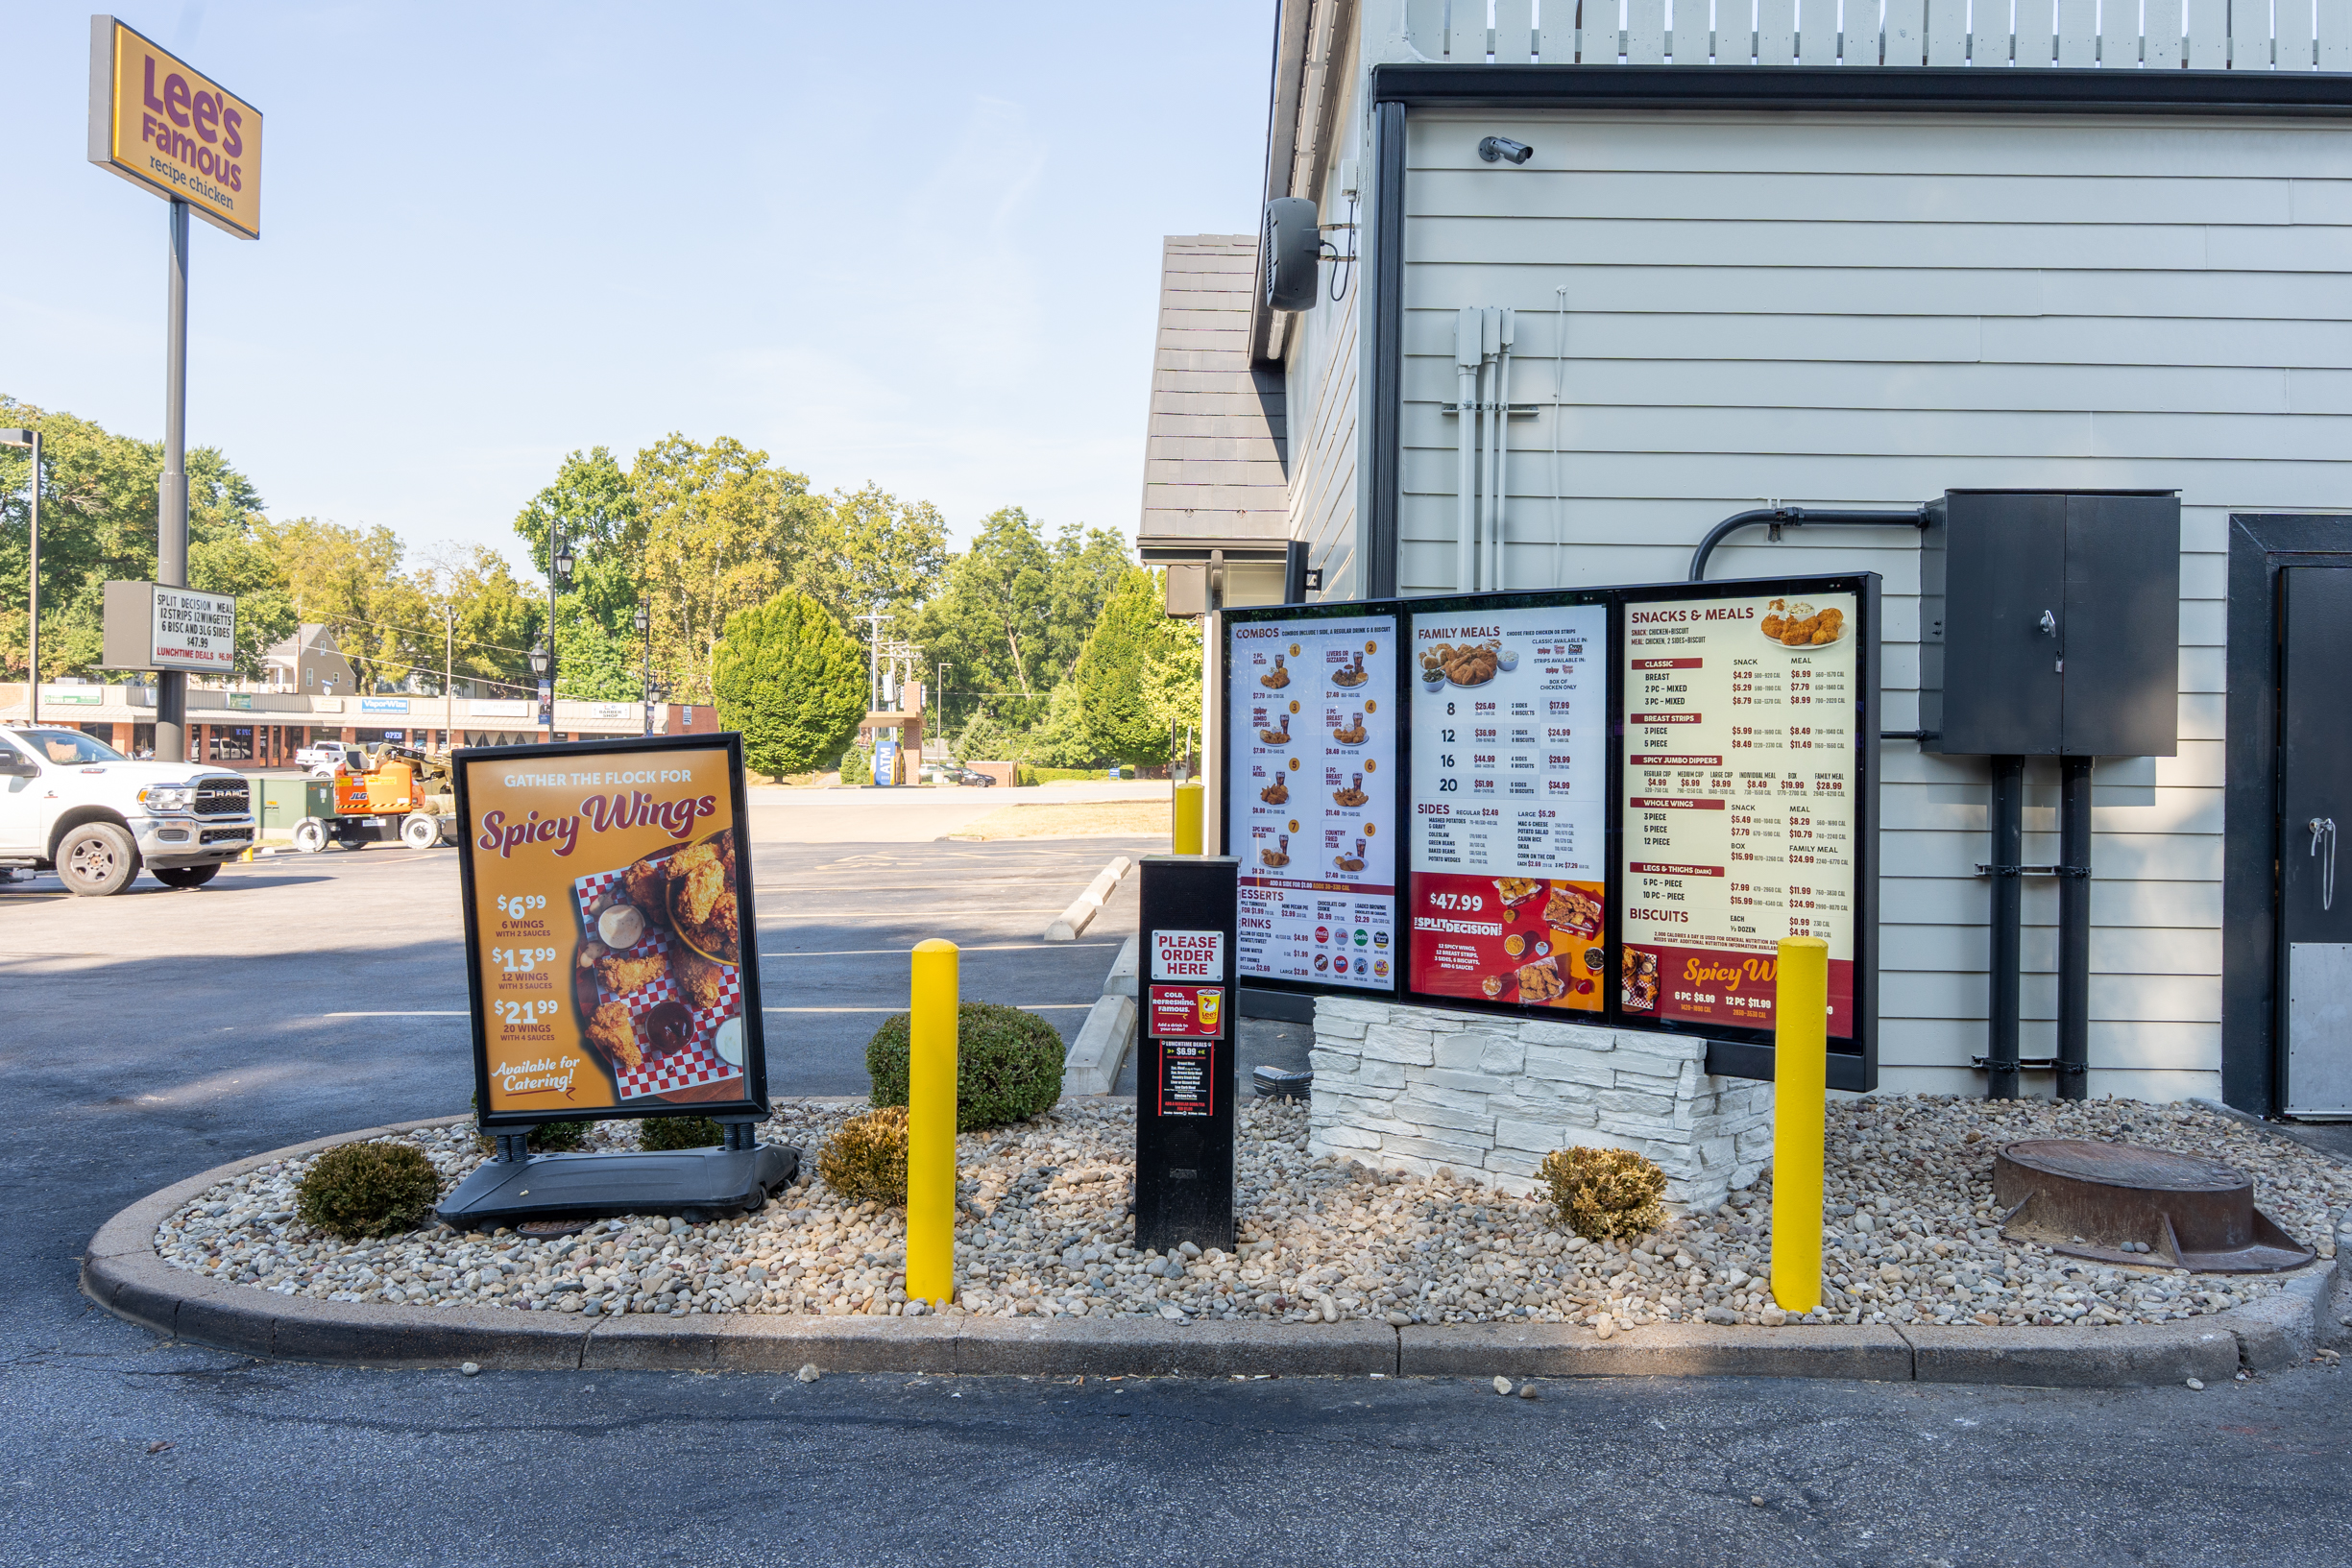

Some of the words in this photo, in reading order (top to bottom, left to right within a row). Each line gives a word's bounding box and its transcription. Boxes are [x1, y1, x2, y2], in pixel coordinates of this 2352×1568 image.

[143, 54, 243, 158] Lee's
[143, 111, 242, 192] Famous
[150, 156, 186, 185] recipe
[189, 176, 233, 210] chicken
[158, 594, 177, 606] SPLIT
[182, 598, 210, 611] DECISION
[217, 602, 233, 614] MEAL
[1632, 611, 1686, 623] SNACKS
[1691, 610, 1702, 621] &
[1705, 607, 1754, 620] MEALS
[162, 621, 166, 631] 6
[168, 622, 183, 633] BISC
[185, 623, 198, 634] AND
[213, 627, 230, 638] SIDES
[1236, 628, 1278, 639] COMBOS
[1418, 628, 1457, 639] FAMILY
[1461, 626, 1500, 638] MEALS
[1649, 627, 1688, 636] CHICKEN+BISCUIT
[187, 637, 207, 648] $47.99
[158, 647, 193, 658] LUNCHTIME
[195, 651, 213, 660] DEALS
[1733, 671, 1752, 680] $4.29
[1447, 702, 1455, 715] 8
[1549, 701, 1569, 710] $17.99
[1442, 730, 1455, 742] 12
[1548, 728, 1570, 737] $24.99
[1733, 726, 1752, 736] $5.99
[1790, 726, 1811, 736] $8.49
[880, 747, 891, 774] ATM
[1441, 754, 1455, 767] 16
[1474, 755, 1495, 763] $44.99
[1549, 755, 1570, 764] $29.99
[504, 774, 567, 787] GATHER
[570, 772, 601, 785] THE
[605, 771, 656, 784] FLOCK
[661, 770, 691, 783] FOR
[1440, 779, 1457, 791] 20
[1474, 779, 1493, 788] $51.99
[1548, 781, 1570, 790] $34.99
[1418, 804, 1450, 814] SIDES
[1482, 808, 1498, 817] $2.49
[1539, 809, 1556, 818] $5.29
[478, 810, 580, 858] Spicy
[580, 790, 716, 839] Wings
[1430, 892, 1483, 912] $47.99
[1630, 908, 1688, 923] BISCUITS
[1789, 917, 1809, 927] $0.99
[1418, 917, 1447, 929] SPLIT
[1446, 923, 1498, 936] DECISION
[1159, 936, 1217, 948] PLEASE
[1161, 950, 1214, 961] ORDER
[1167, 963, 1207, 975] HERE
[1684, 957, 1742, 991] Spicy
[516, 973, 548, 981] WINGS
[1681, 992, 1691, 1001] PC
[1694, 993, 1715, 1003] $6.99
[1726, 996, 1734, 1005] 12
[1734, 997, 1745, 1006] PC
[1748, 999, 1771, 1008] $11.99
[492, 1057, 555, 1077] Available
[560, 1056, 580, 1069] for
[503, 1069, 573, 1092] Catering!
